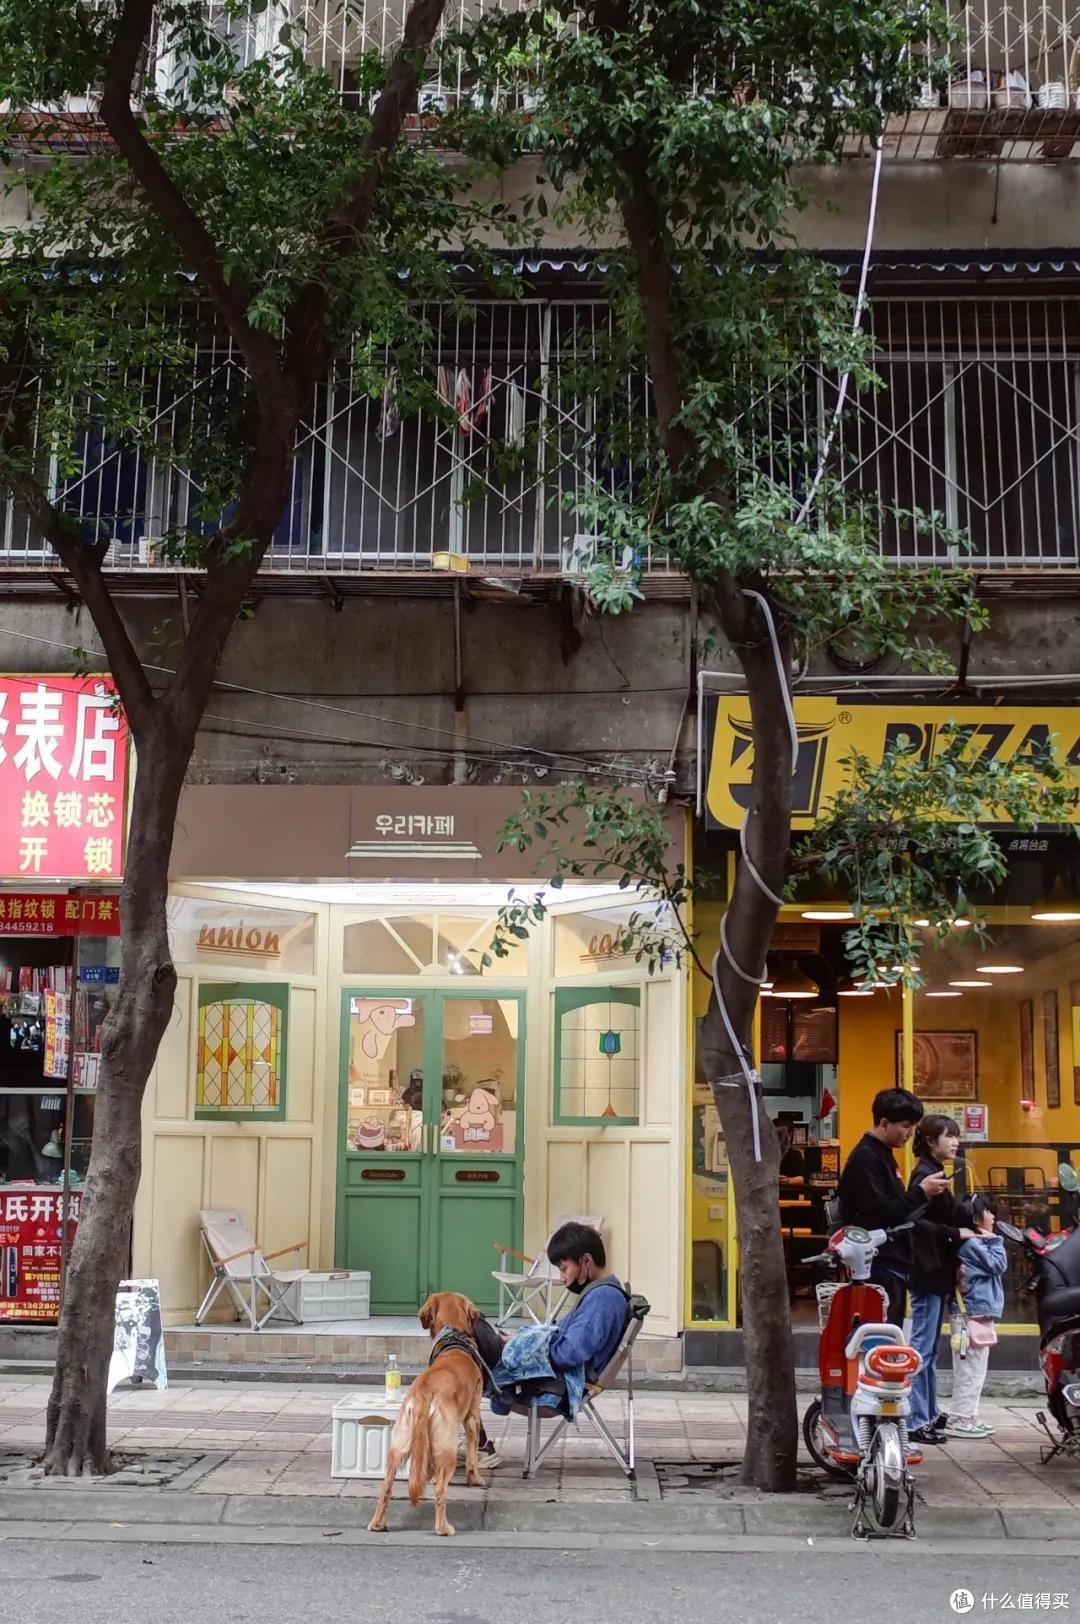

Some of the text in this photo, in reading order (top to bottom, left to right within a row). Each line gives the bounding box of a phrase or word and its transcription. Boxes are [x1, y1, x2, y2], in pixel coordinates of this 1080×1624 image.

[882, 722, 1052, 773] PIZZA
[21, 790, 116, 829] 换锁芯
[375, 815, 454, 836] 우리카페
[1008, 839, 1049, 851] 点将台店
[199, 920, 279, 952] union
[0, 1195, 80, 1222] 氏开锁
